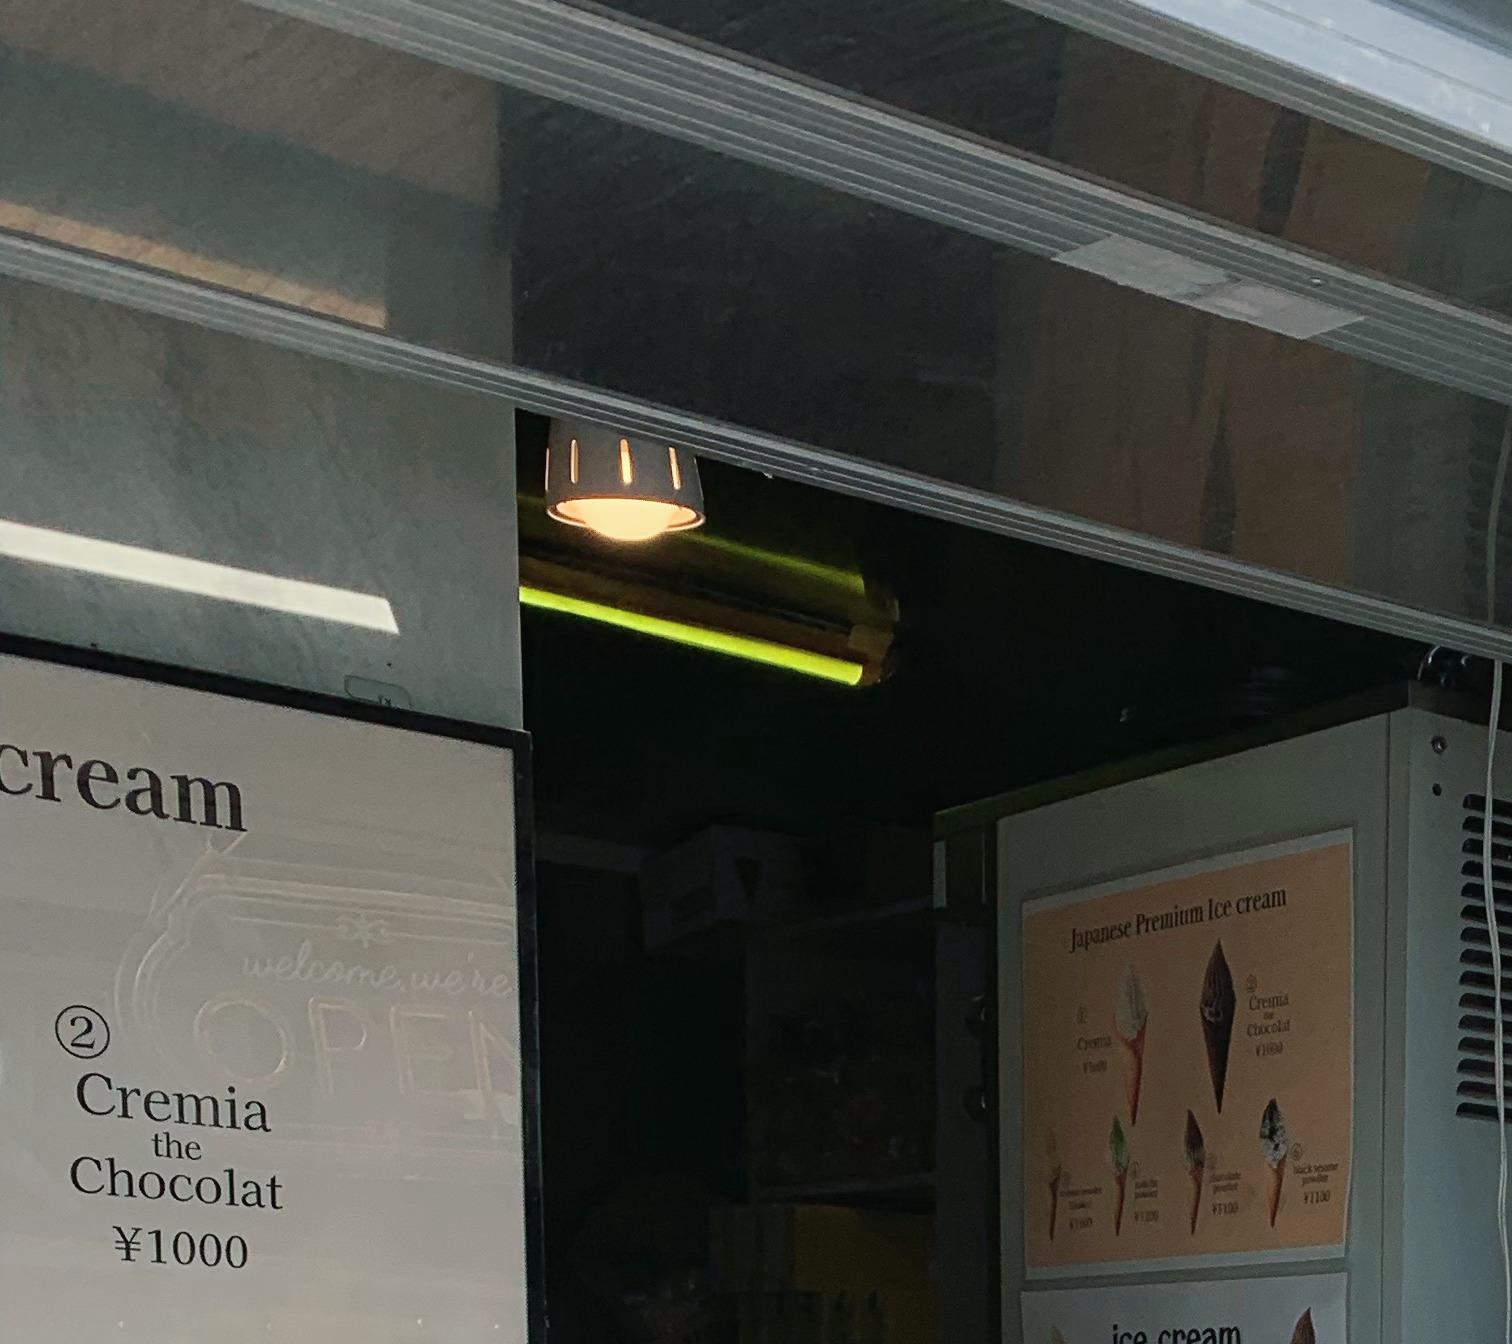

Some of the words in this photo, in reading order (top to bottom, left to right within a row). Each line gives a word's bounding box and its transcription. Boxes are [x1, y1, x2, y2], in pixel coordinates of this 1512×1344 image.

[0, 742, 248, 833] cream
[1069, 922, 1132, 954] Japanese
[1135, 903, 1205, 937] Premium
[1208, 897, 1233, 921] Ice
[1236, 888, 1287, 917] cream
[75, 1072, 272, 1132] Cremia
[151, 1132, 203, 1161] the
[69, 1156, 284, 1210] Chocolat
[112, 1225, 250, 1269] ¥1000
